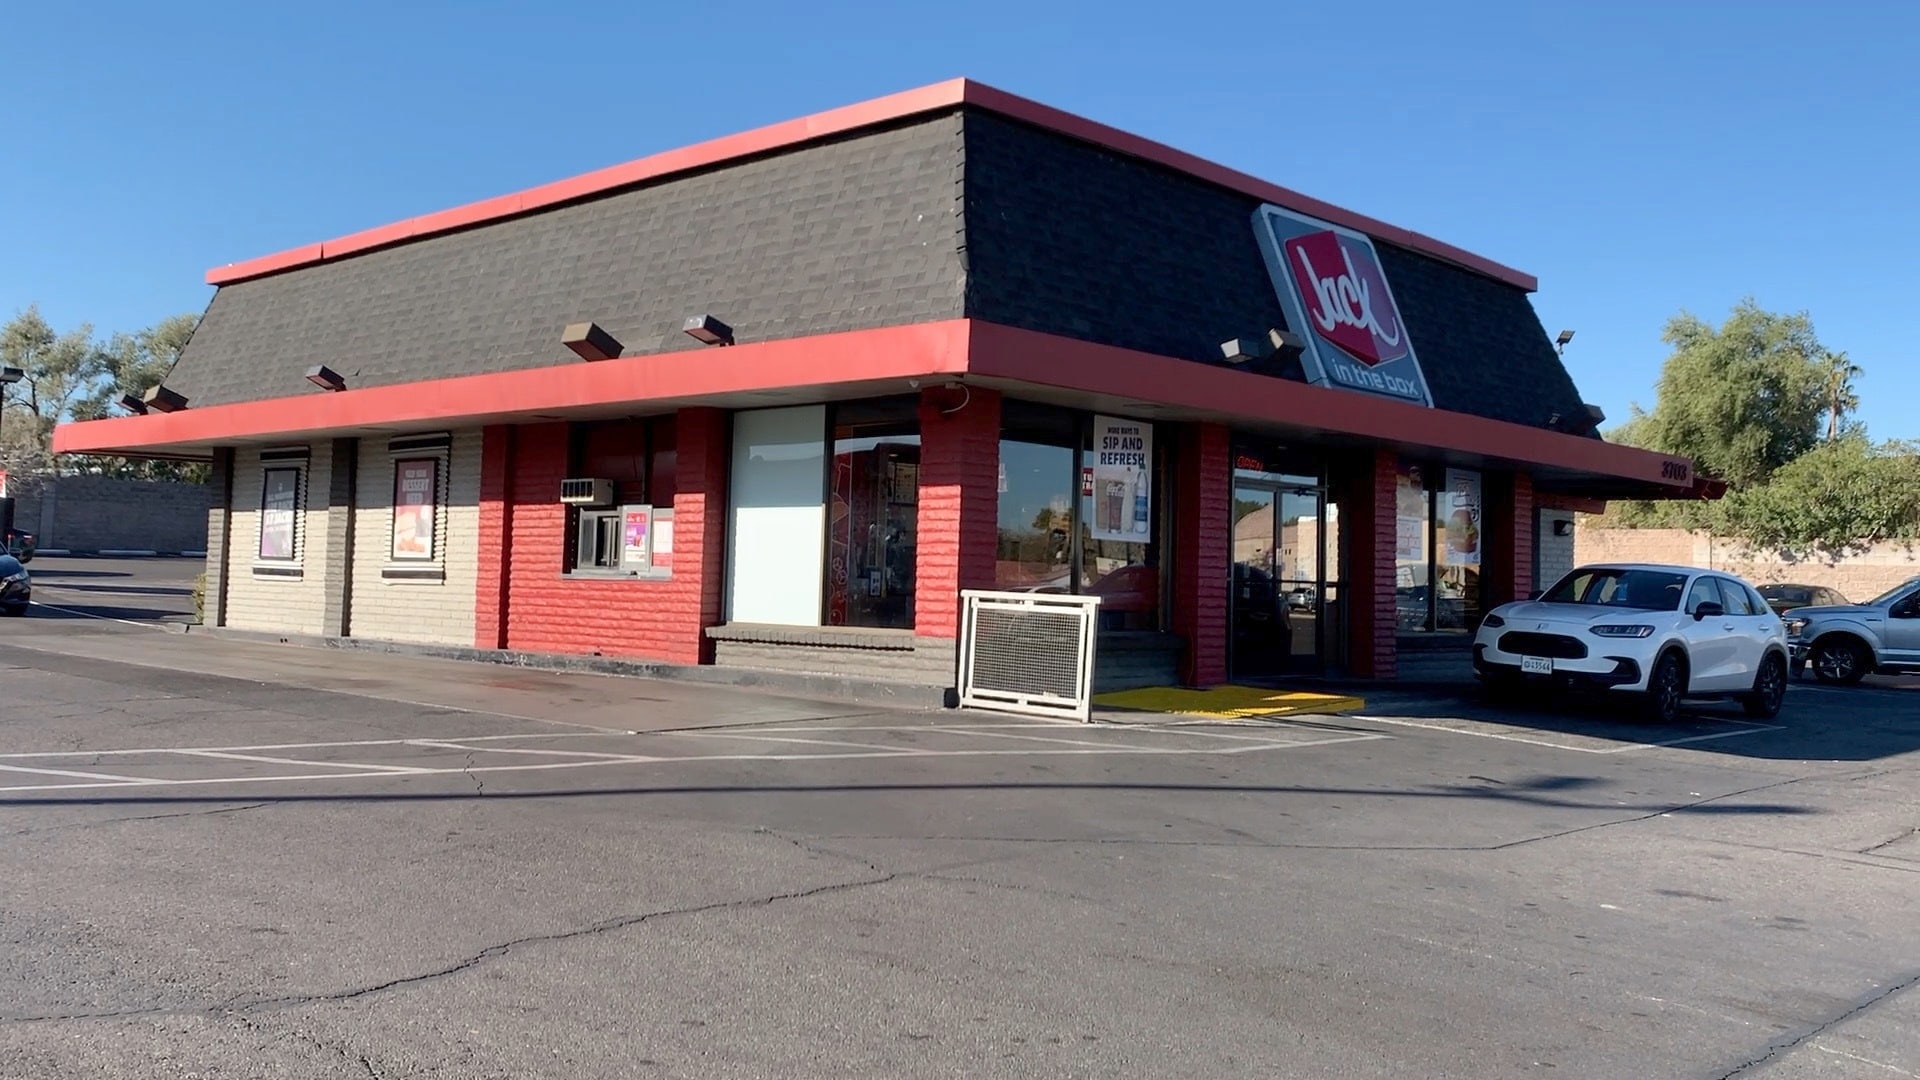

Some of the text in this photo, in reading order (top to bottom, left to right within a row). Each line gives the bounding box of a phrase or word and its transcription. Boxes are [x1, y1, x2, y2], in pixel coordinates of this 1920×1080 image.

[1296, 245, 1400, 347] Jack
[1332, 358, 1418, 396] in the box
[1103, 436, 1143, 450] SIP AND
[1100, 452, 1145, 466] REFRESH
